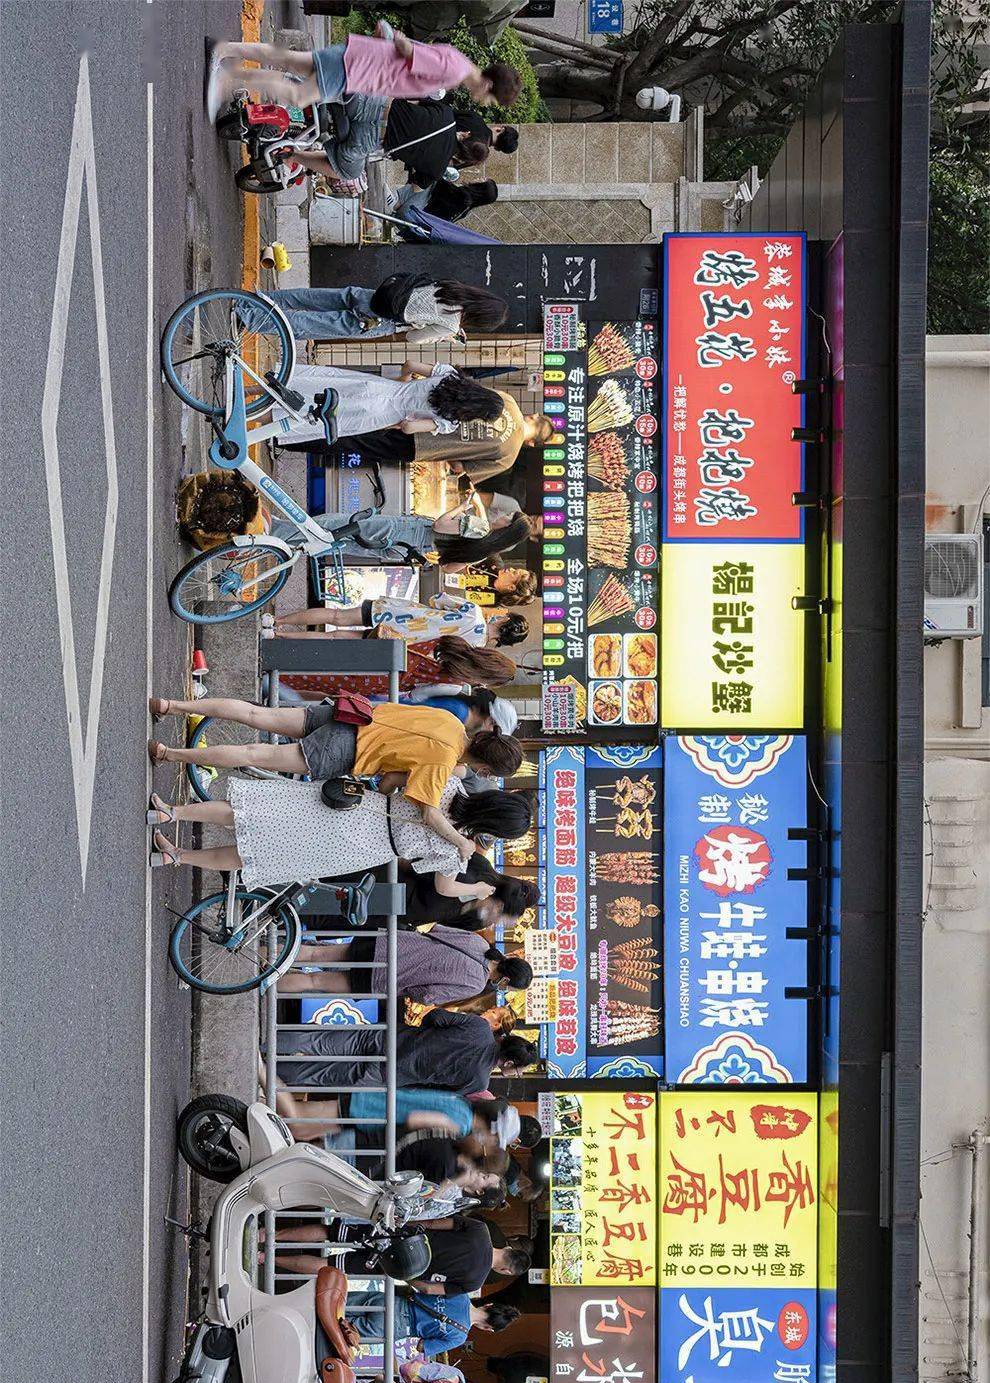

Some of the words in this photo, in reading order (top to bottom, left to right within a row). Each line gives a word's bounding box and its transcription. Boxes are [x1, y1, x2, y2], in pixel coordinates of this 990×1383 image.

[566, 367, 585, 537] 专注原汁烧烤把把烧
[566, 558, 585, 659] 全场10元/把
[555, 770, 578, 867] 绝味烤面筋
[679, 855, 689, 883] MIZHI
[679, 889, 689, 912] KAO
[555, 875, 578, 971] 超级大豆皮
[679, 918, 689, 953] NIUWA
[679, 957, 689, 1027] CHUANSHAO
[596, 1109, 652, 1281] 不二香豆腐
[662, 1149, 815, 1229] 香豆腐
[662, 1263, 805, 1277] 始创于2009年
[667, 1243, 789, 1258] 成都市建设巷
